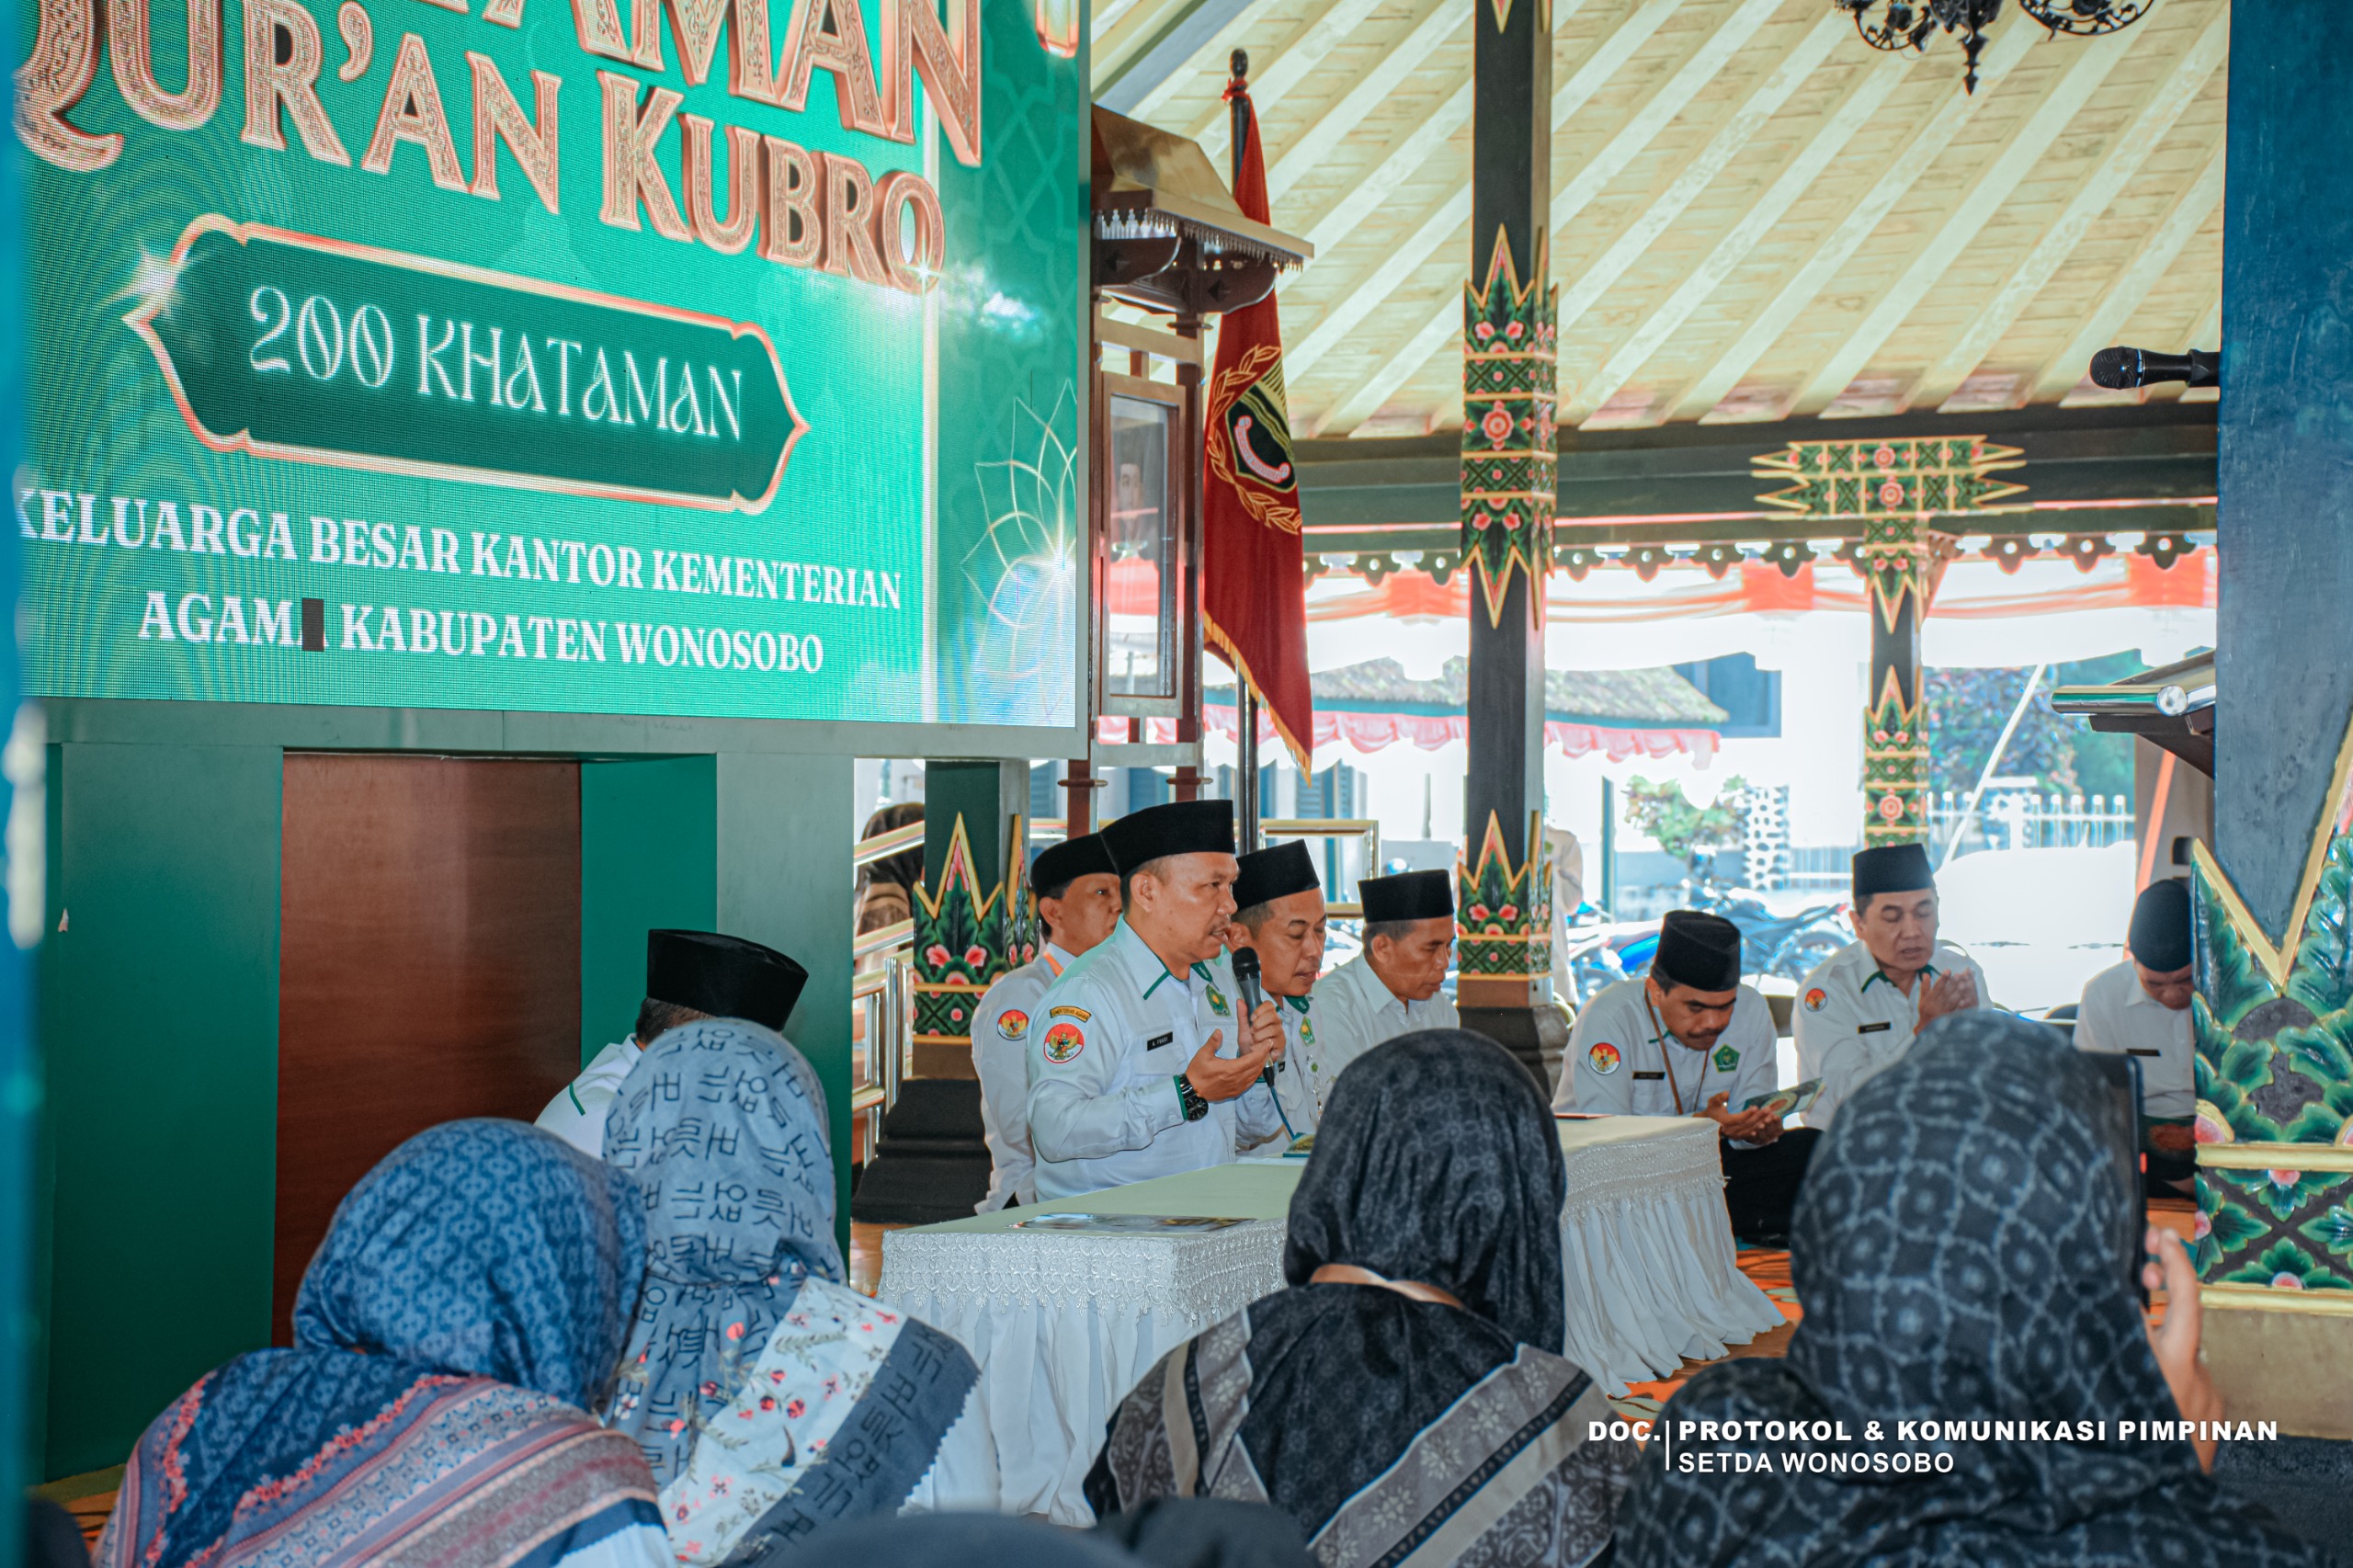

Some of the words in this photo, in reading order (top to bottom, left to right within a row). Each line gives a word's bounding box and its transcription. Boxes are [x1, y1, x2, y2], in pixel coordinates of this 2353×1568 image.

[597, 69, 946, 296] KUBRO
[249, 285, 395, 389] 200
[415, 313, 744, 442] KHATAMAN
[309, 515, 462, 574] BESAR
[470, 531, 645, 589] KANTOR
[652, 549, 902, 610] KEMENTERIAN
[138, 590, 328, 647] AGAM
[340, 603, 608, 663] KABUPATEN
[614, 622, 825, 674] WONOSOBO
